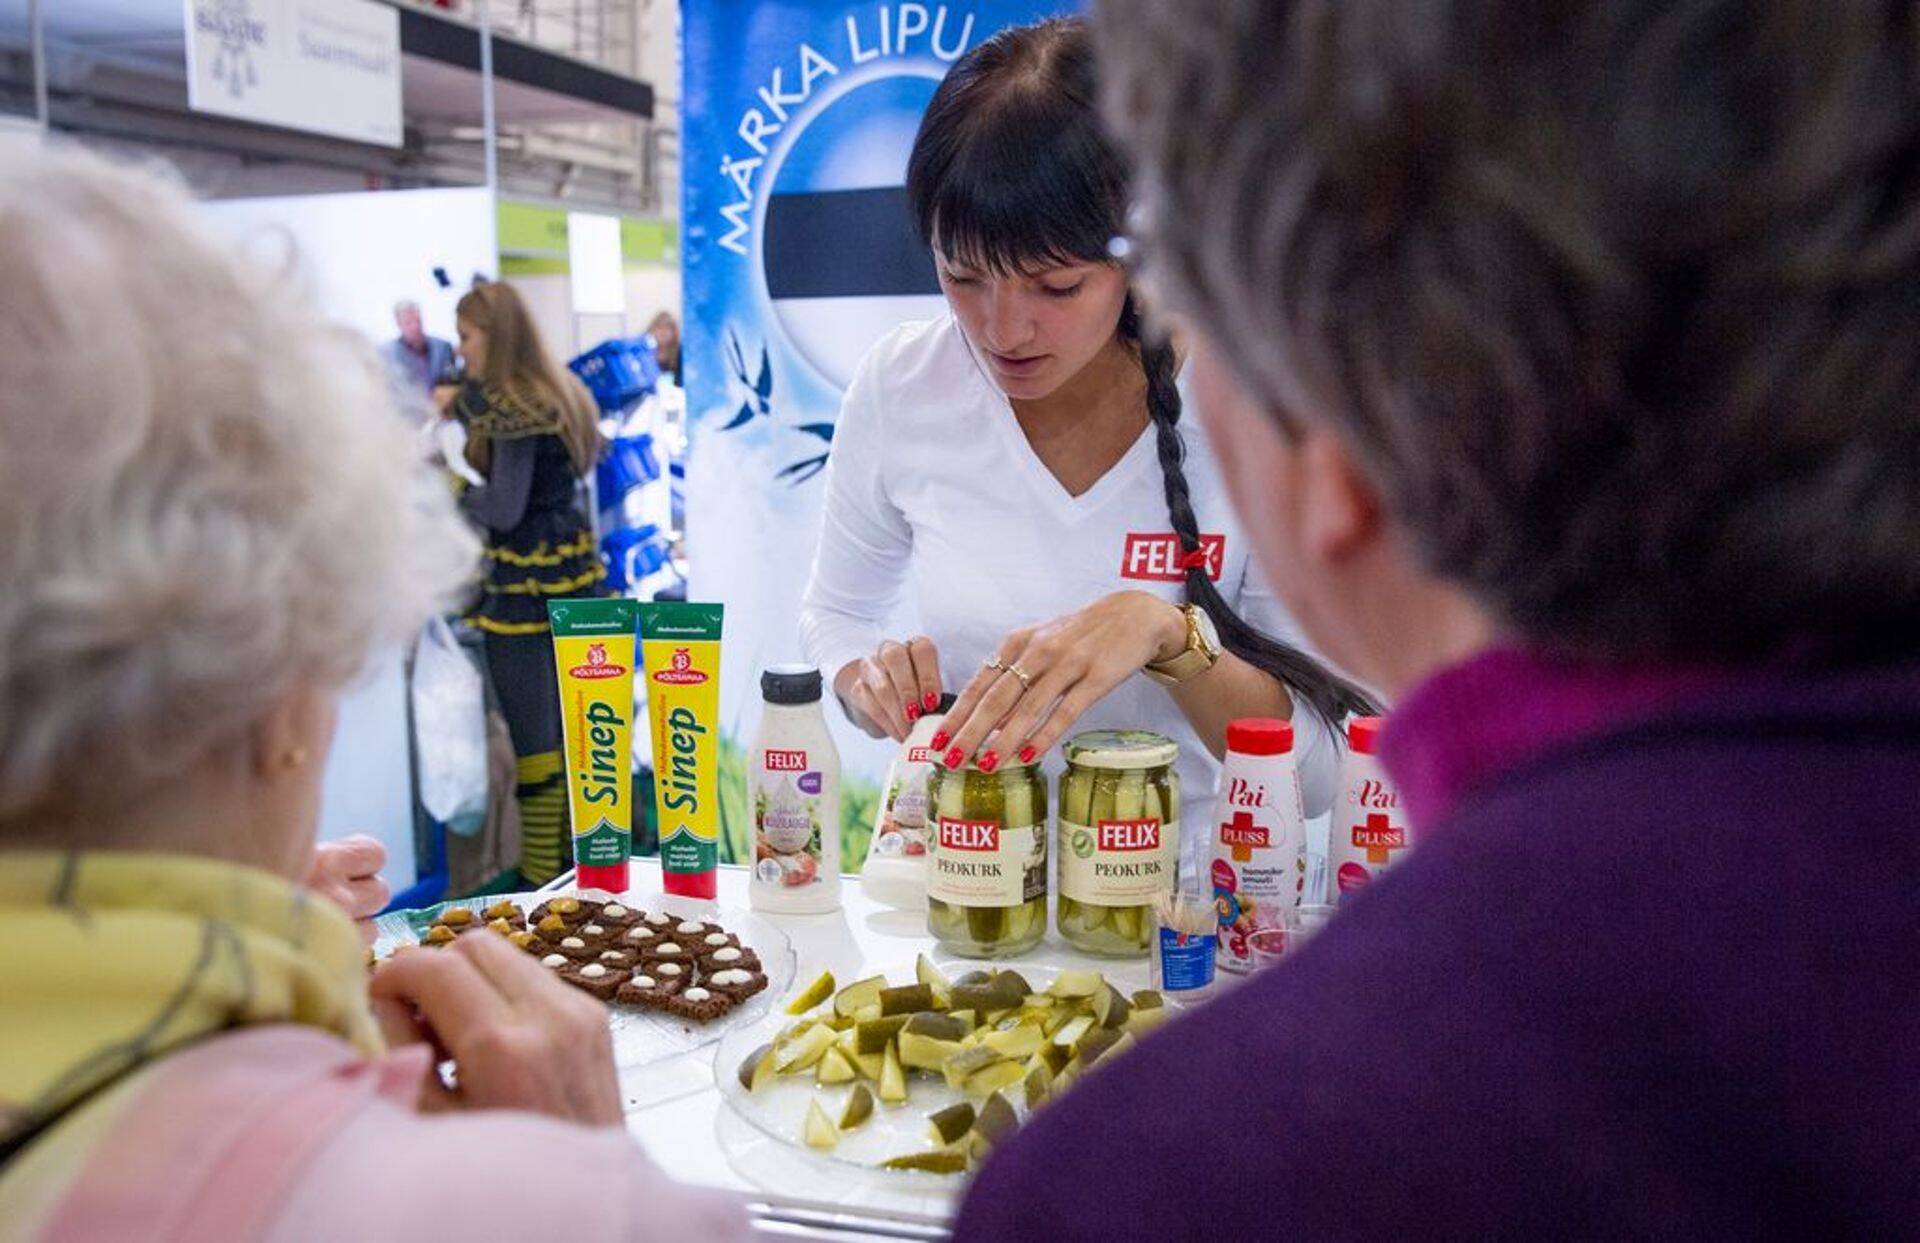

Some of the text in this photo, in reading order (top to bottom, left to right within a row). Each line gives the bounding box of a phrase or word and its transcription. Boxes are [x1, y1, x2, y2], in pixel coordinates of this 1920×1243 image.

[717, 3, 974, 255] MÄRKA LIPU
[1129, 540, 1218, 576] FELX
[580, 702, 625, 807] Sinep
[661, 708, 706, 814] Sinep
[768, 752, 804, 769] FELIX
[1228, 778, 1265, 807] Pai
[942, 821, 995, 848] FELIX
[1102, 823, 1157, 848] FELIX
[1223, 829, 1267, 844] PLUSS
[1356, 829, 1402, 845] PLUSS
[938, 859, 1002, 877] PEOKURK
[1095, 861, 1162, 877] PEOKURK
